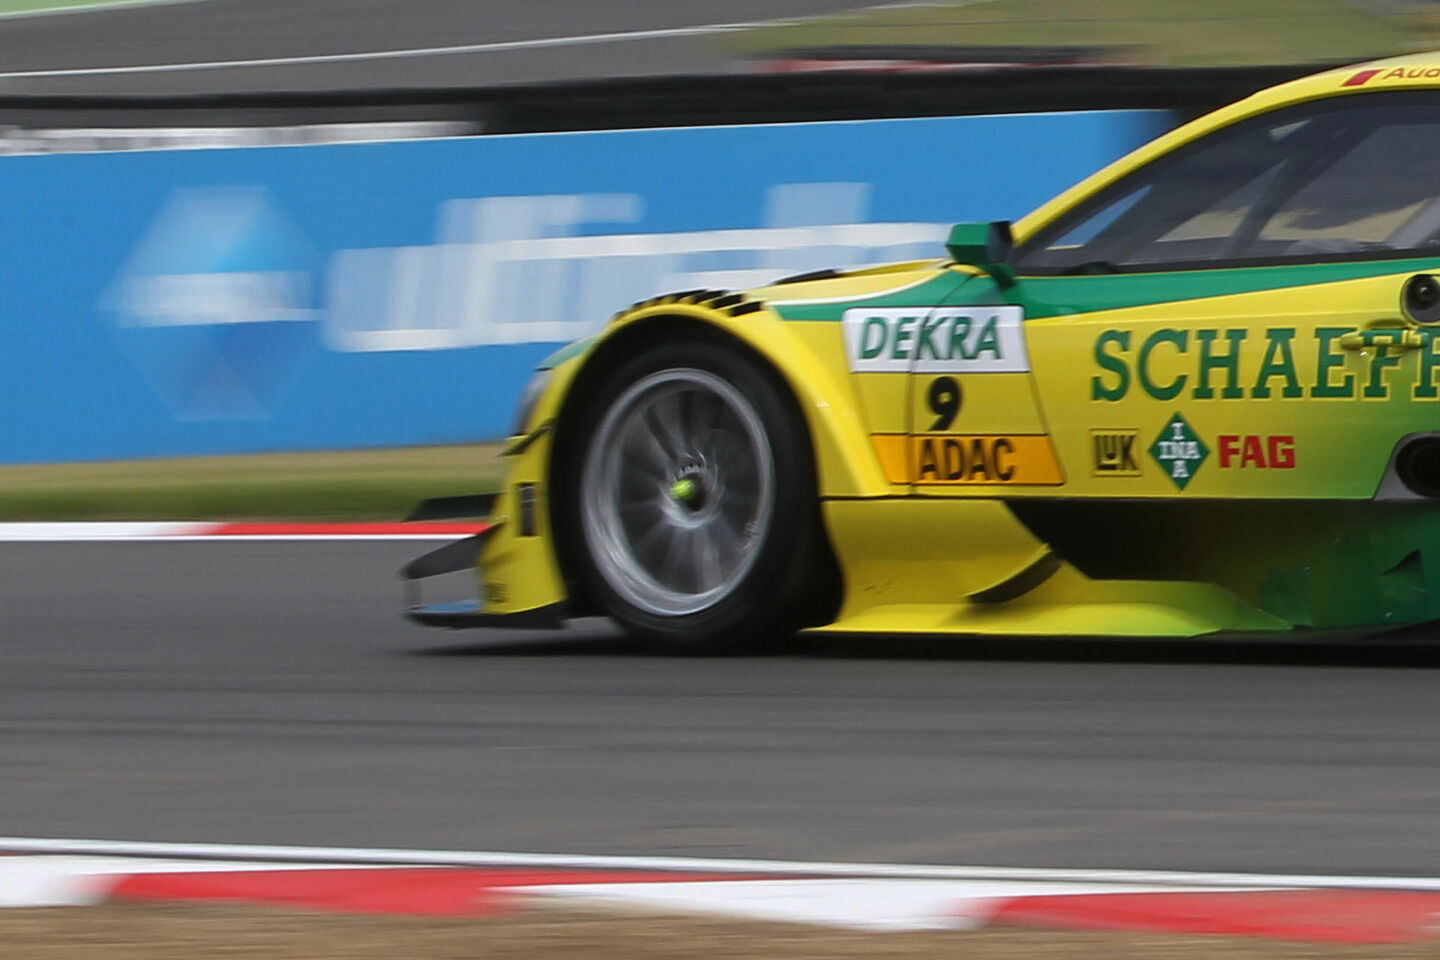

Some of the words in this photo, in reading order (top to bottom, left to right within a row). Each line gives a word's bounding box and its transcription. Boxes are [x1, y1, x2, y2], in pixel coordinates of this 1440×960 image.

[858, 315, 1004, 361] DEKRA
[924, 375, 963, 432] 9
[919, 438, 1015, 482] ADAC
[1217, 435, 1296, 469] FAG
